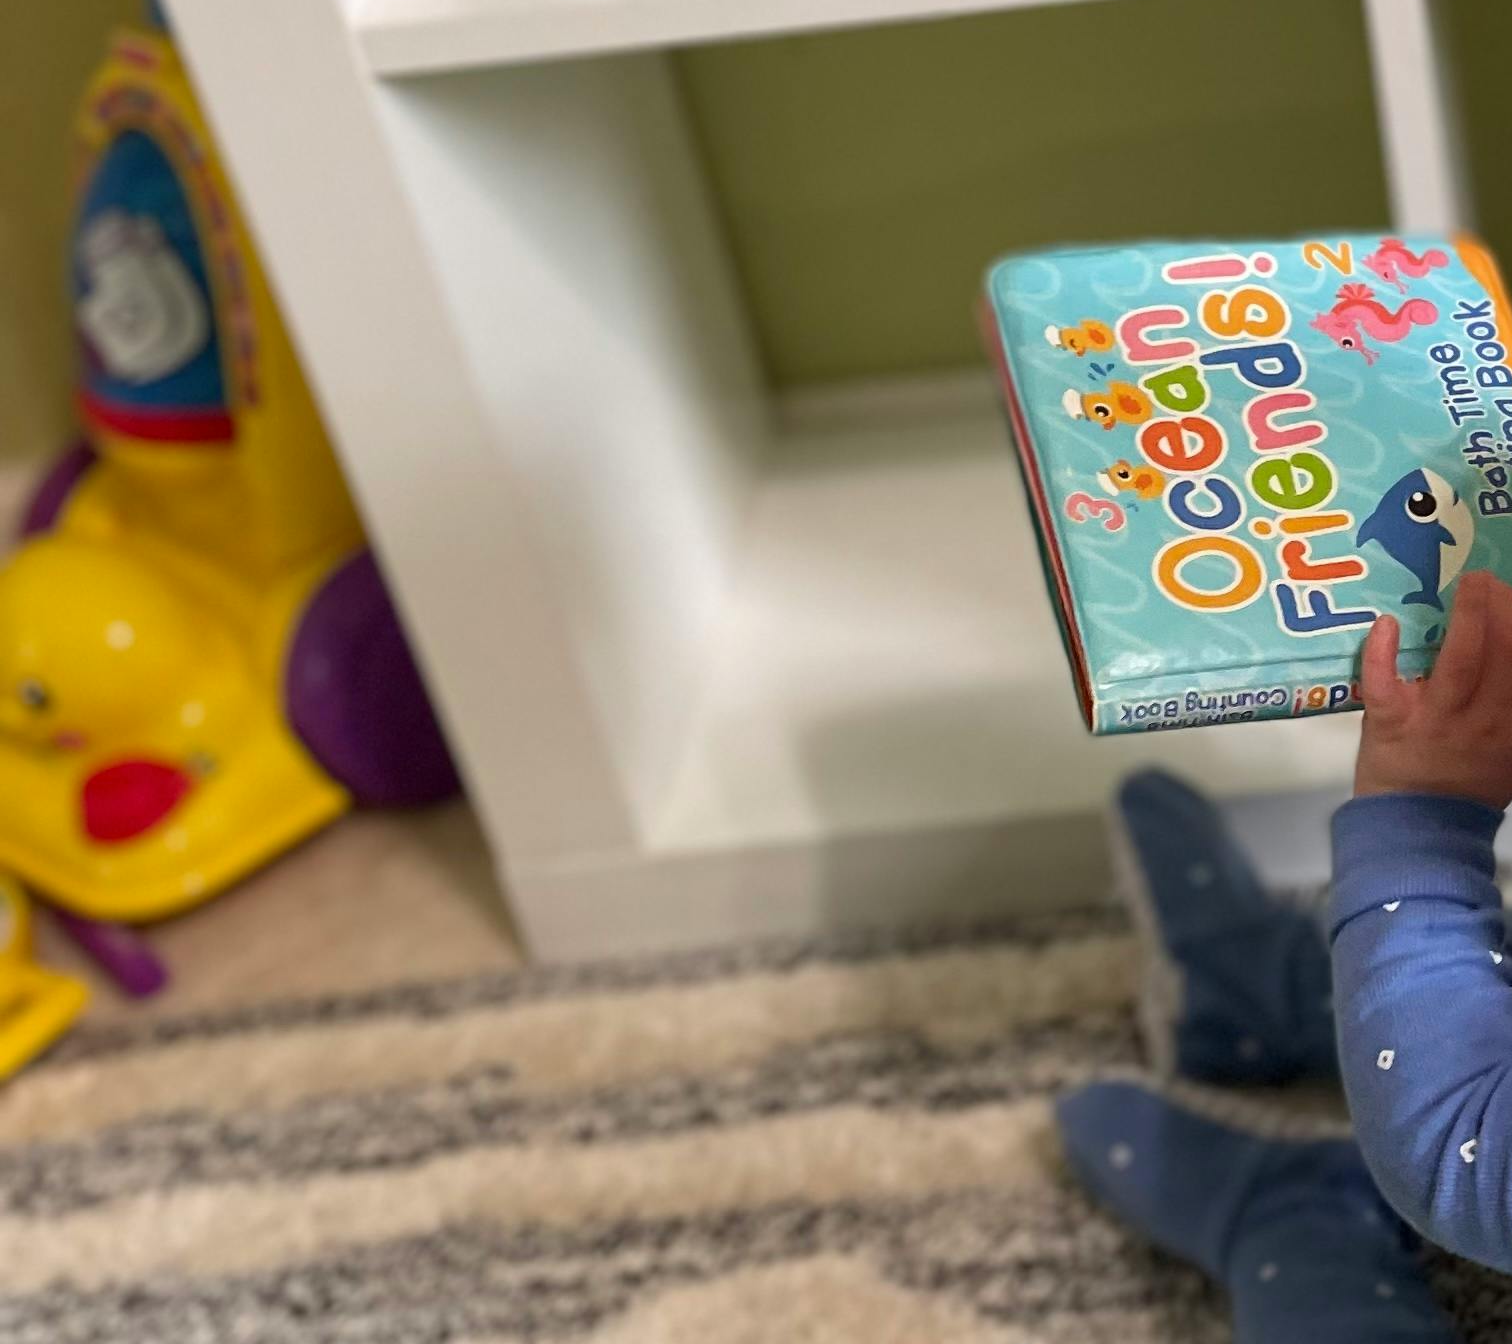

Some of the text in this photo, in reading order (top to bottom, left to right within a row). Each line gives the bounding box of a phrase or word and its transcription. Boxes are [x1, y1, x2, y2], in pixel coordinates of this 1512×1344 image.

[1304, 241, 1353, 274] 2
[1429, 343, 1486, 427] Time
[1118, 307, 1263, 612] Ocean
[1166, 256, 1378, 633] Friends!
[1066, 492, 1126, 530] 3
[1120, 699, 1179, 724] Book
[1184, 689, 1287, 714] Counting
